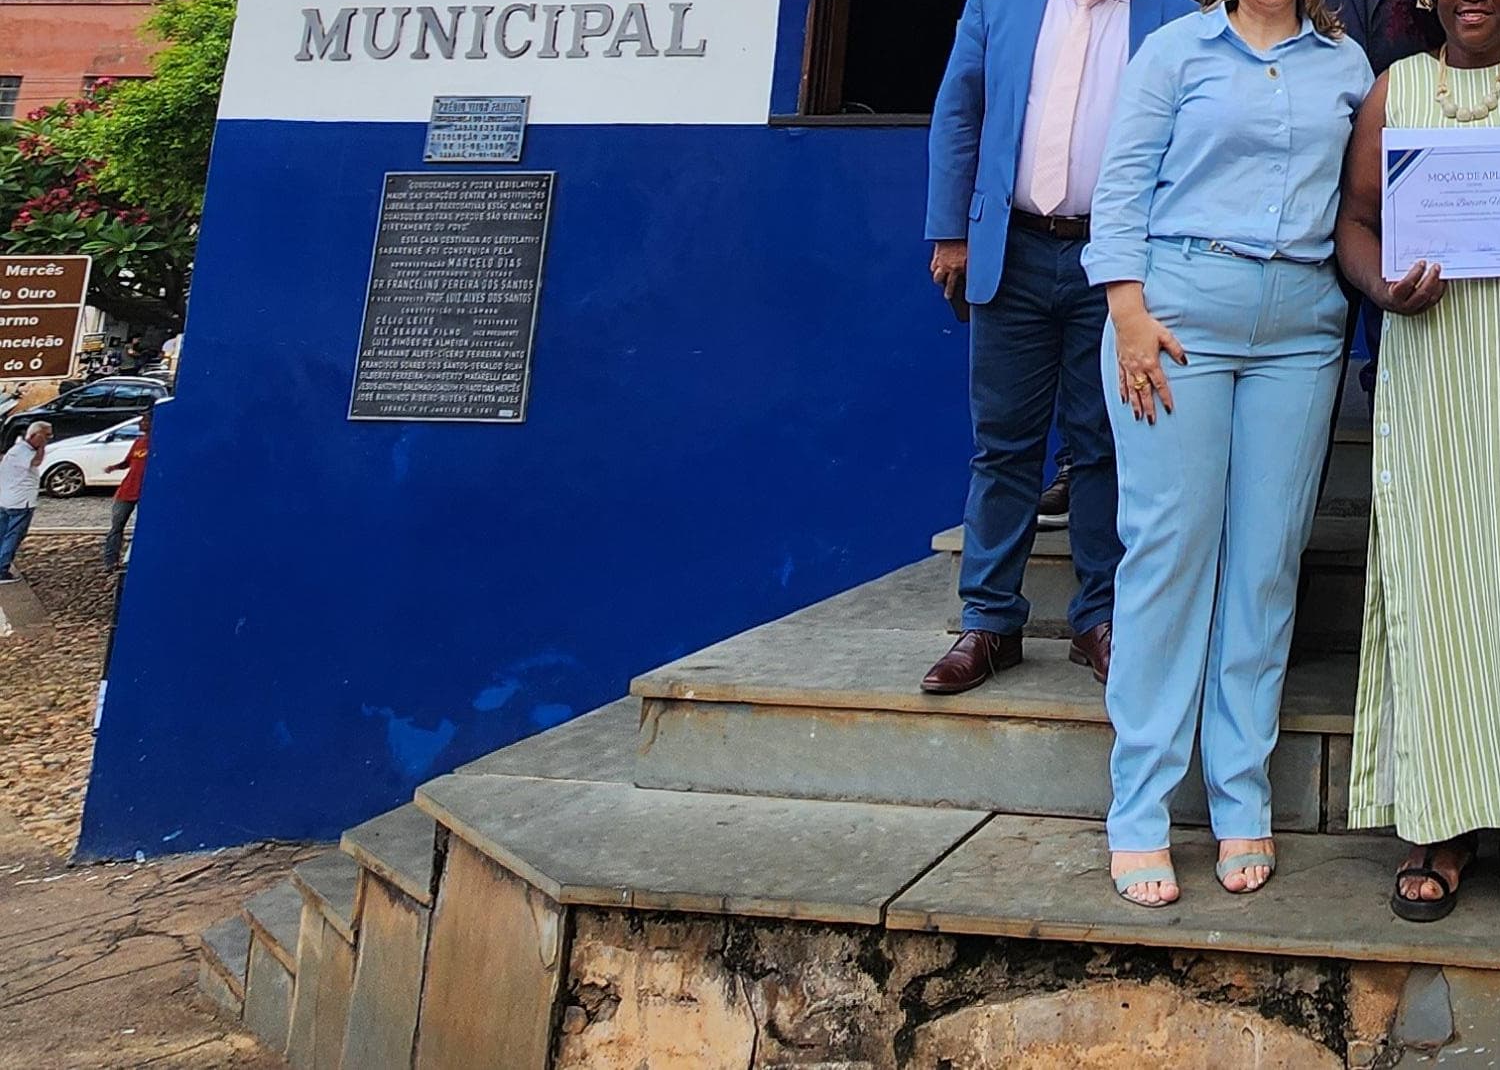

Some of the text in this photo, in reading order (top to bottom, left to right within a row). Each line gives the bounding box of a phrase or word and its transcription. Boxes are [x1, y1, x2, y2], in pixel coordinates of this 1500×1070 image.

[295, 2, 707, 61] MUNICIPAL
[1428, 171, 1464, 183] MOÇÃO
[1467, 171, 1480, 180] DE
[448, 258, 494, 268] MARCELO
[497, 258, 522, 268] DIAS
[5, 263, 64, 277] Mercês
[387, 279, 440, 290] FRANCELINO
[441, 279, 479, 290] PEREIRA
[481, 279, 498, 290] DOS
[500, 279, 534, 290] SANTOS
[0, 287, 56, 299] o Ouro
[463, 293, 486, 303] ALVES
[487, 293, 502, 303] DOS
[504, 293, 532, 303] SANTOS
[407, 316, 435, 325] LEITE
[4, 352, 43, 371] do Ó
